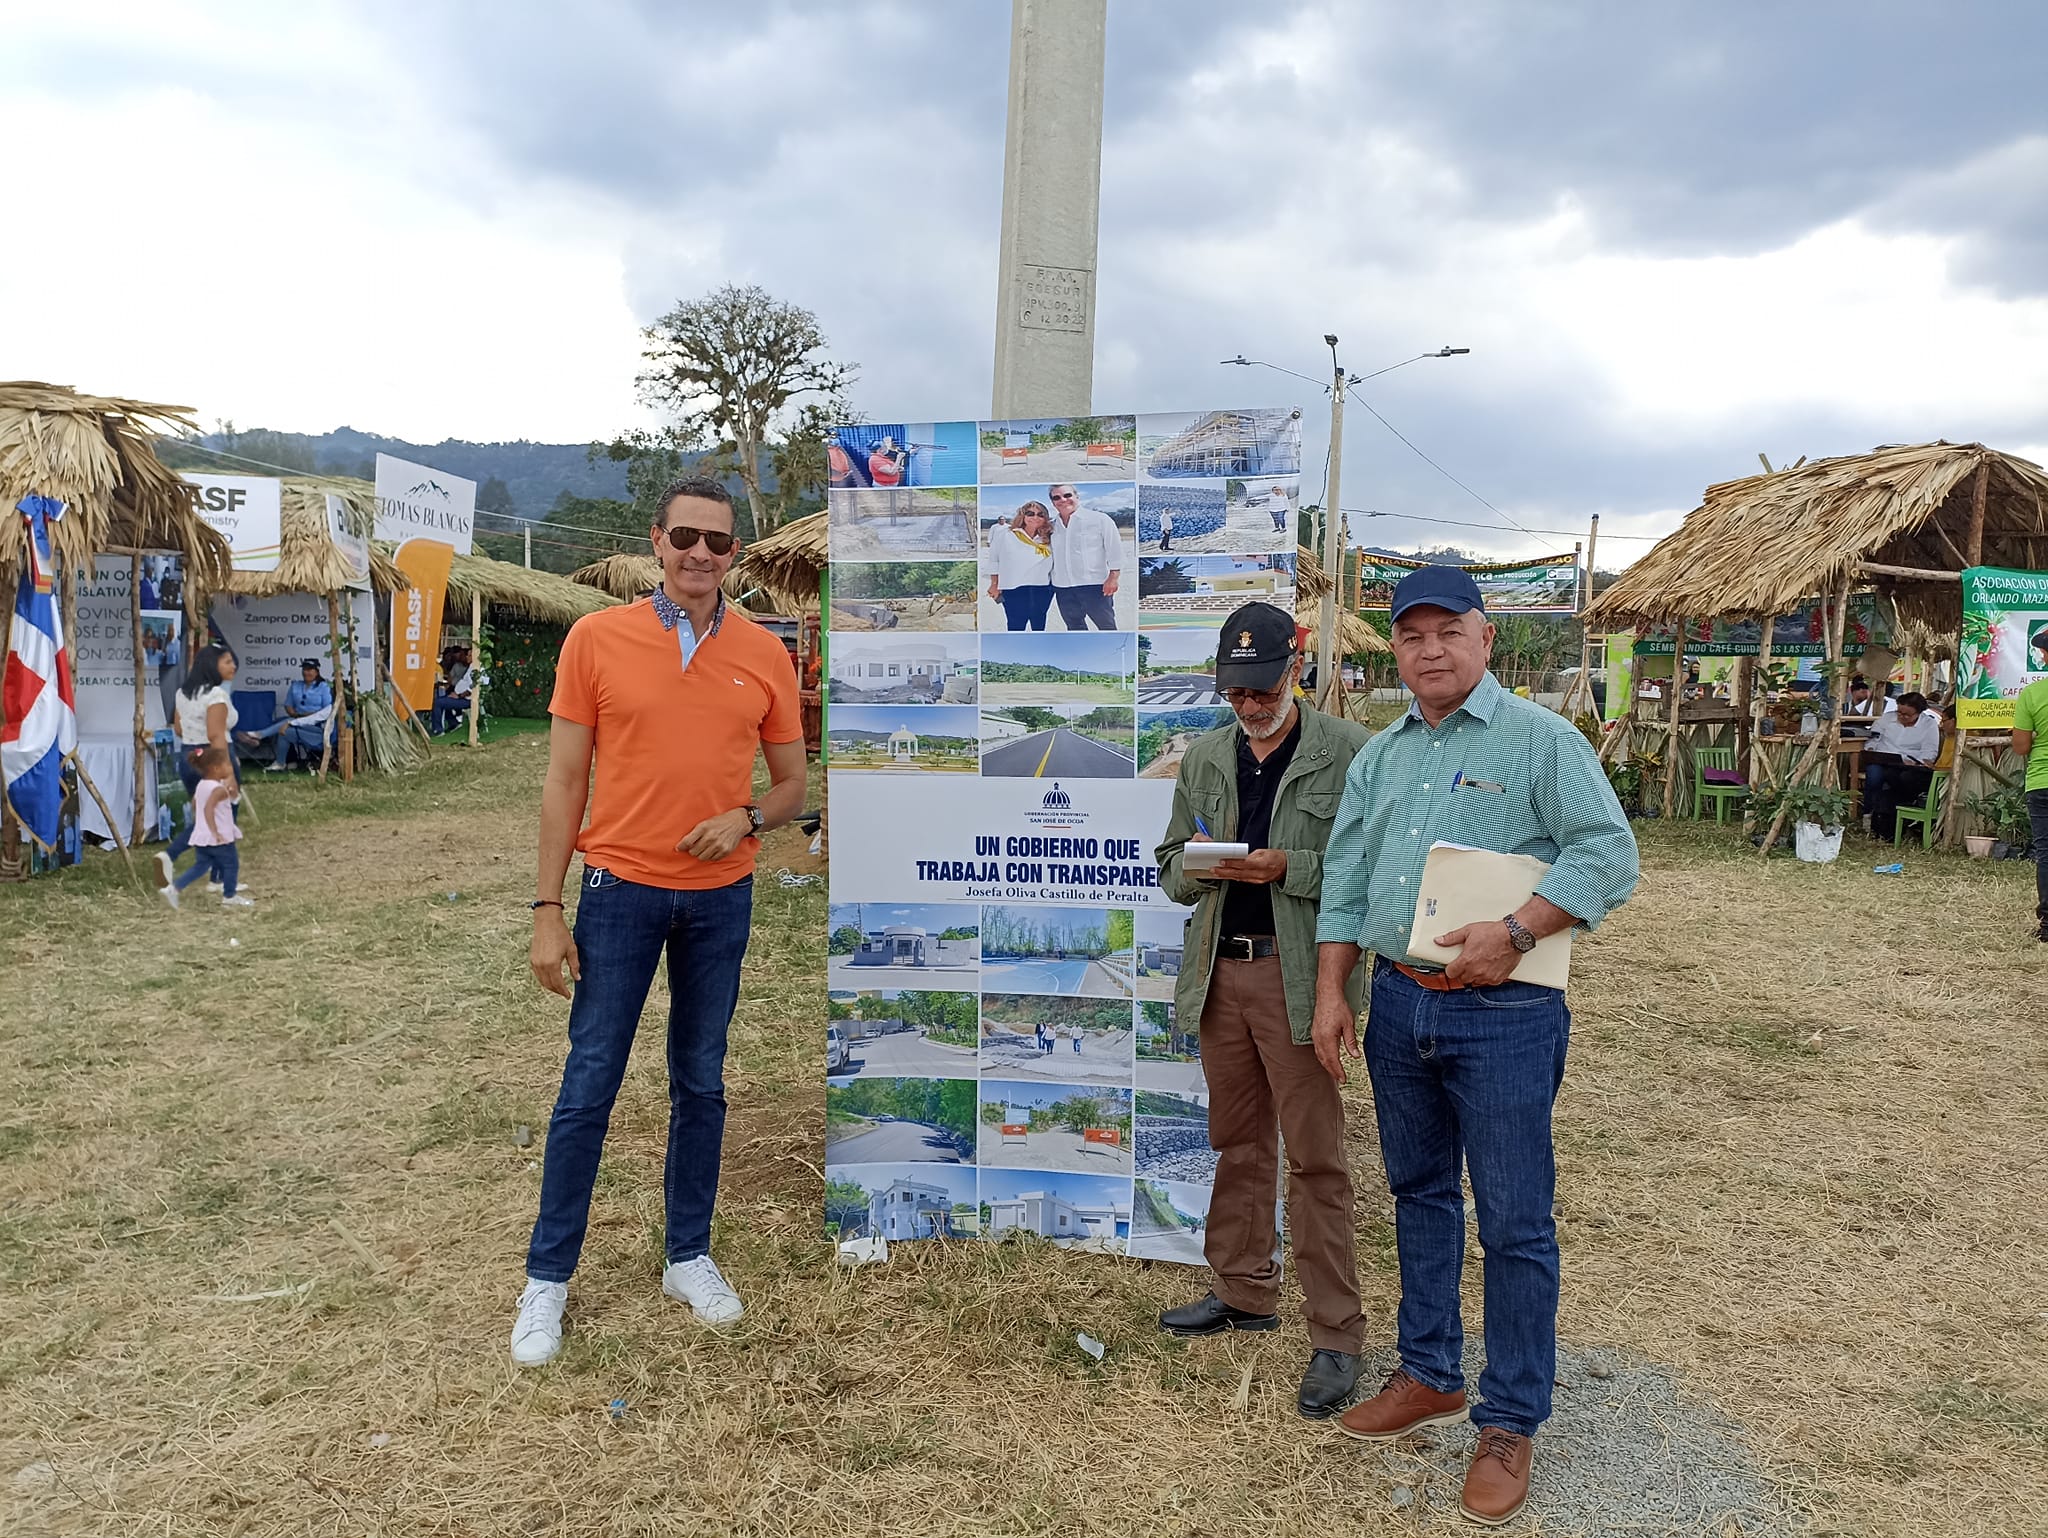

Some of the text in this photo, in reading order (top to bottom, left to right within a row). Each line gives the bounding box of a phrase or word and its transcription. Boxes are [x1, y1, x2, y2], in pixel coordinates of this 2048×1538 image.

[191, 486, 247, 512] ASF
[423, 507, 470, 534] BLANCAS
[1972, 576, 2036, 590] ASOCIACIÓN
[1971, 592, 2019, 604] ORLANDO
[244, 613, 288, 624] Zampro
[291, 614, 311, 624] DM
[313, 615, 330, 624] 52
[405, 587, 422, 641] BASF
[105, 627, 124, 639] DE
[244, 634, 285, 645] Cabrio
[288, 635, 311, 646] Top
[1783, 644, 1801, 654] LAS
[245, 656, 281, 666] Serifel
[285, 657, 298, 666] 10
[245, 677, 283, 686] Cabrio
[1980, 702, 2008, 711] CUENCA
[1966, 710, 1995, 718] RANCHO
[975, 835, 1140, 862] UN GOBIERNO QUE
[916, 860, 1000, 882] TRABAJA
[1005, 862, 1042, 883] CON
[965, 886, 1149, 902] Josefa Oliva Castillo de Peralta
